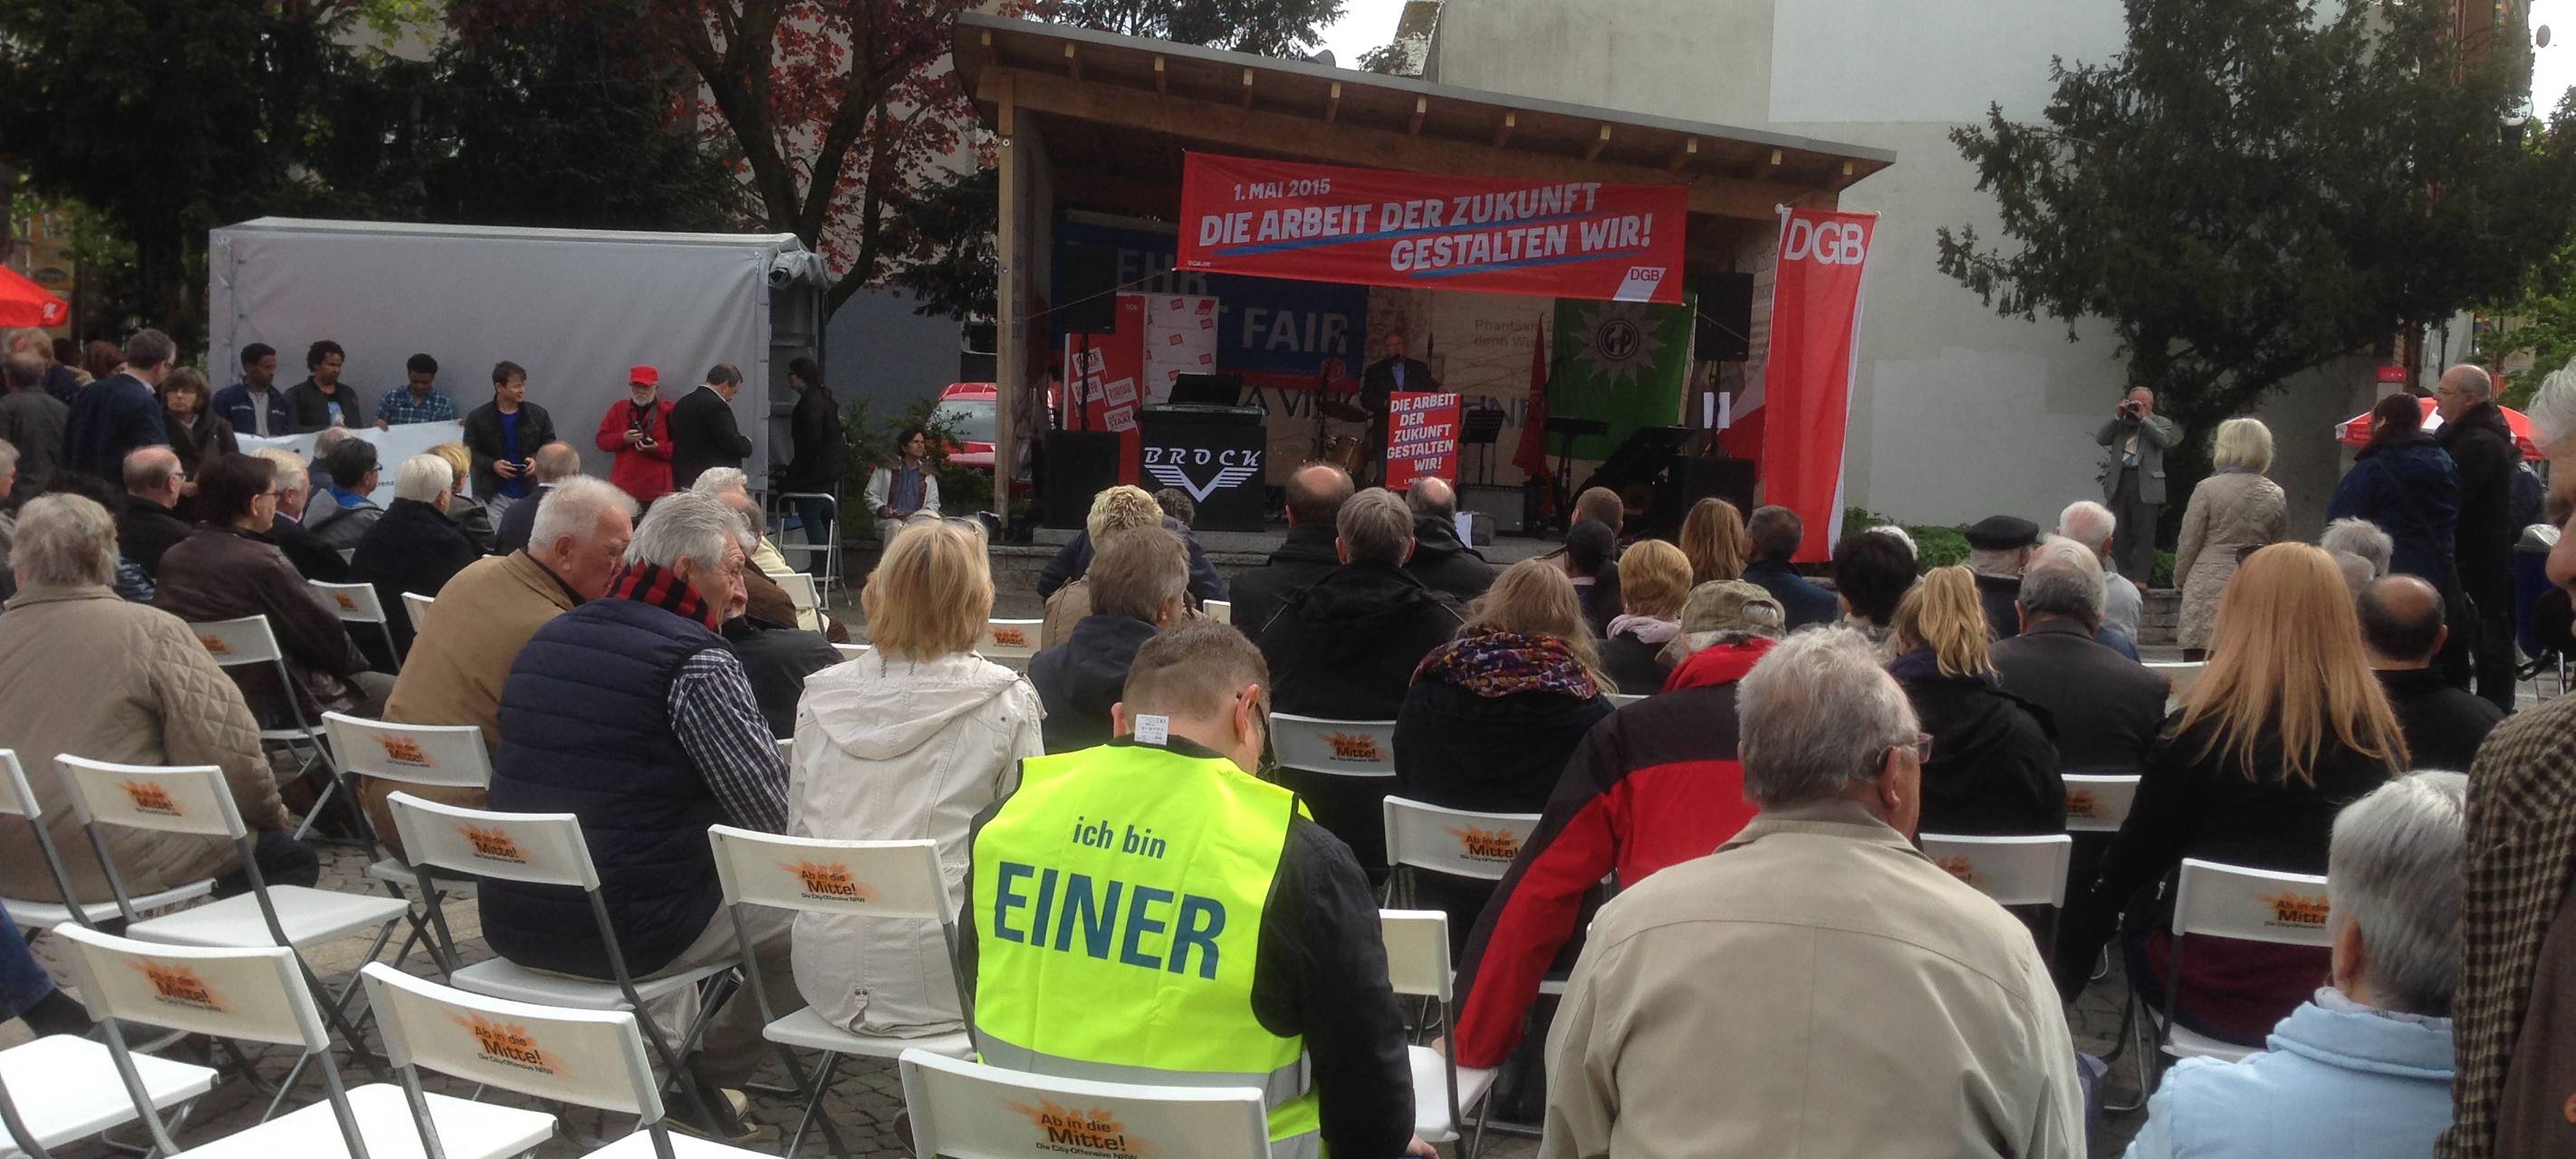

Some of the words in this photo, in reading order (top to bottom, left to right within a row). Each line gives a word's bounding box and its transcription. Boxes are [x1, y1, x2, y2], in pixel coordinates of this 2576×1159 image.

[1234, 184, 1246, 201] 1.
[1249, 180, 1283, 200] MAI
[1289, 178, 1331, 196] 2015
[1199, 212, 1253, 246] DIE
[1257, 204, 1371, 241] ARBEIT
[1379, 199, 1445, 232] DER
[1449, 183, 1601, 225] ZUKUNFT
[1390, 225, 1568, 271] GESTALTEN
[1580, 213, 1653, 252] WIR!
[1784, 217, 1864, 265] DGB
[1630, 268, 1659, 282] DGB
[1241, 308, 1348, 354] FAIR
[1391, 398, 1411, 412] DIE
[1413, 393, 1456, 409] ARBEIT
[1399, 412, 1425, 426] DER
[1394, 424, 1452, 443] ZUKUNFT
[1144, 446, 1261, 466] BROCK
[1387, 439, 1454, 459] GESTALTEN
[1414, 456, 1442, 472] WIR!
[1336, 746, 1376, 758] Mitte!
[1072, 816, 1114, 849] ich
[1122, 824, 1167, 859] bin
[802, 870, 815, 879] Ab
[818, 871, 827, 880] in
[830, 872, 846, 882] die
[806, 880, 857, 896] Mitte!
[995, 860, 1226, 980] EINER
[2278, 909, 2327, 924] Mitte
[475, 1026, 492, 1039] Ab
[508, 1034, 527, 1047] die
[482, 1039, 543, 1065] Mitte!
[1042, 1114, 1062, 1126] Ab
[1068, 1116, 1081, 1129] in
[1087, 1120, 1111, 1133] die
[1036, 1142, 1051, 1151] Die
[1047, 1125, 1126, 1152] Mitte!
